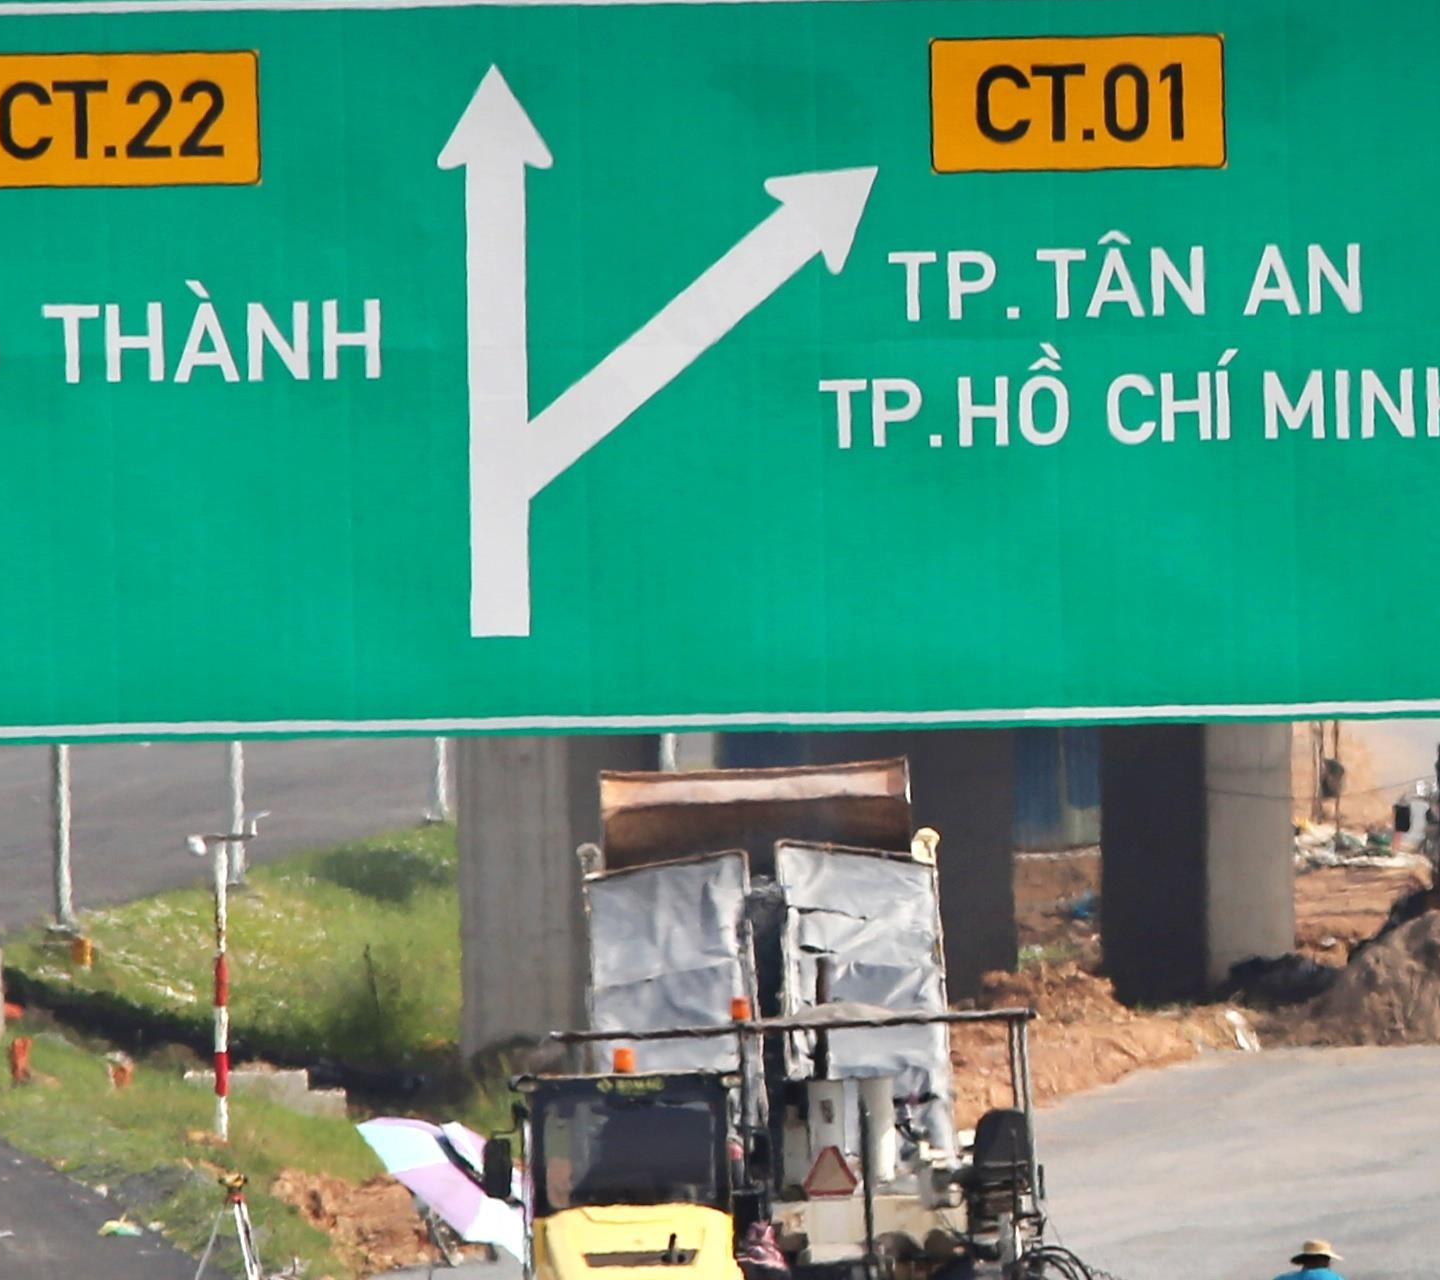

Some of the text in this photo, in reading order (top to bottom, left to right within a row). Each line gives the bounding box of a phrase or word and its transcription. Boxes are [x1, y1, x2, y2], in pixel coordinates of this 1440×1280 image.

[974, 62, 1186, 145] CT.01
[1243, 243, 1363, 316] AN
[42, 280, 382, 384] THÀNH
[1106, 348, 1239, 446] CHÍ
